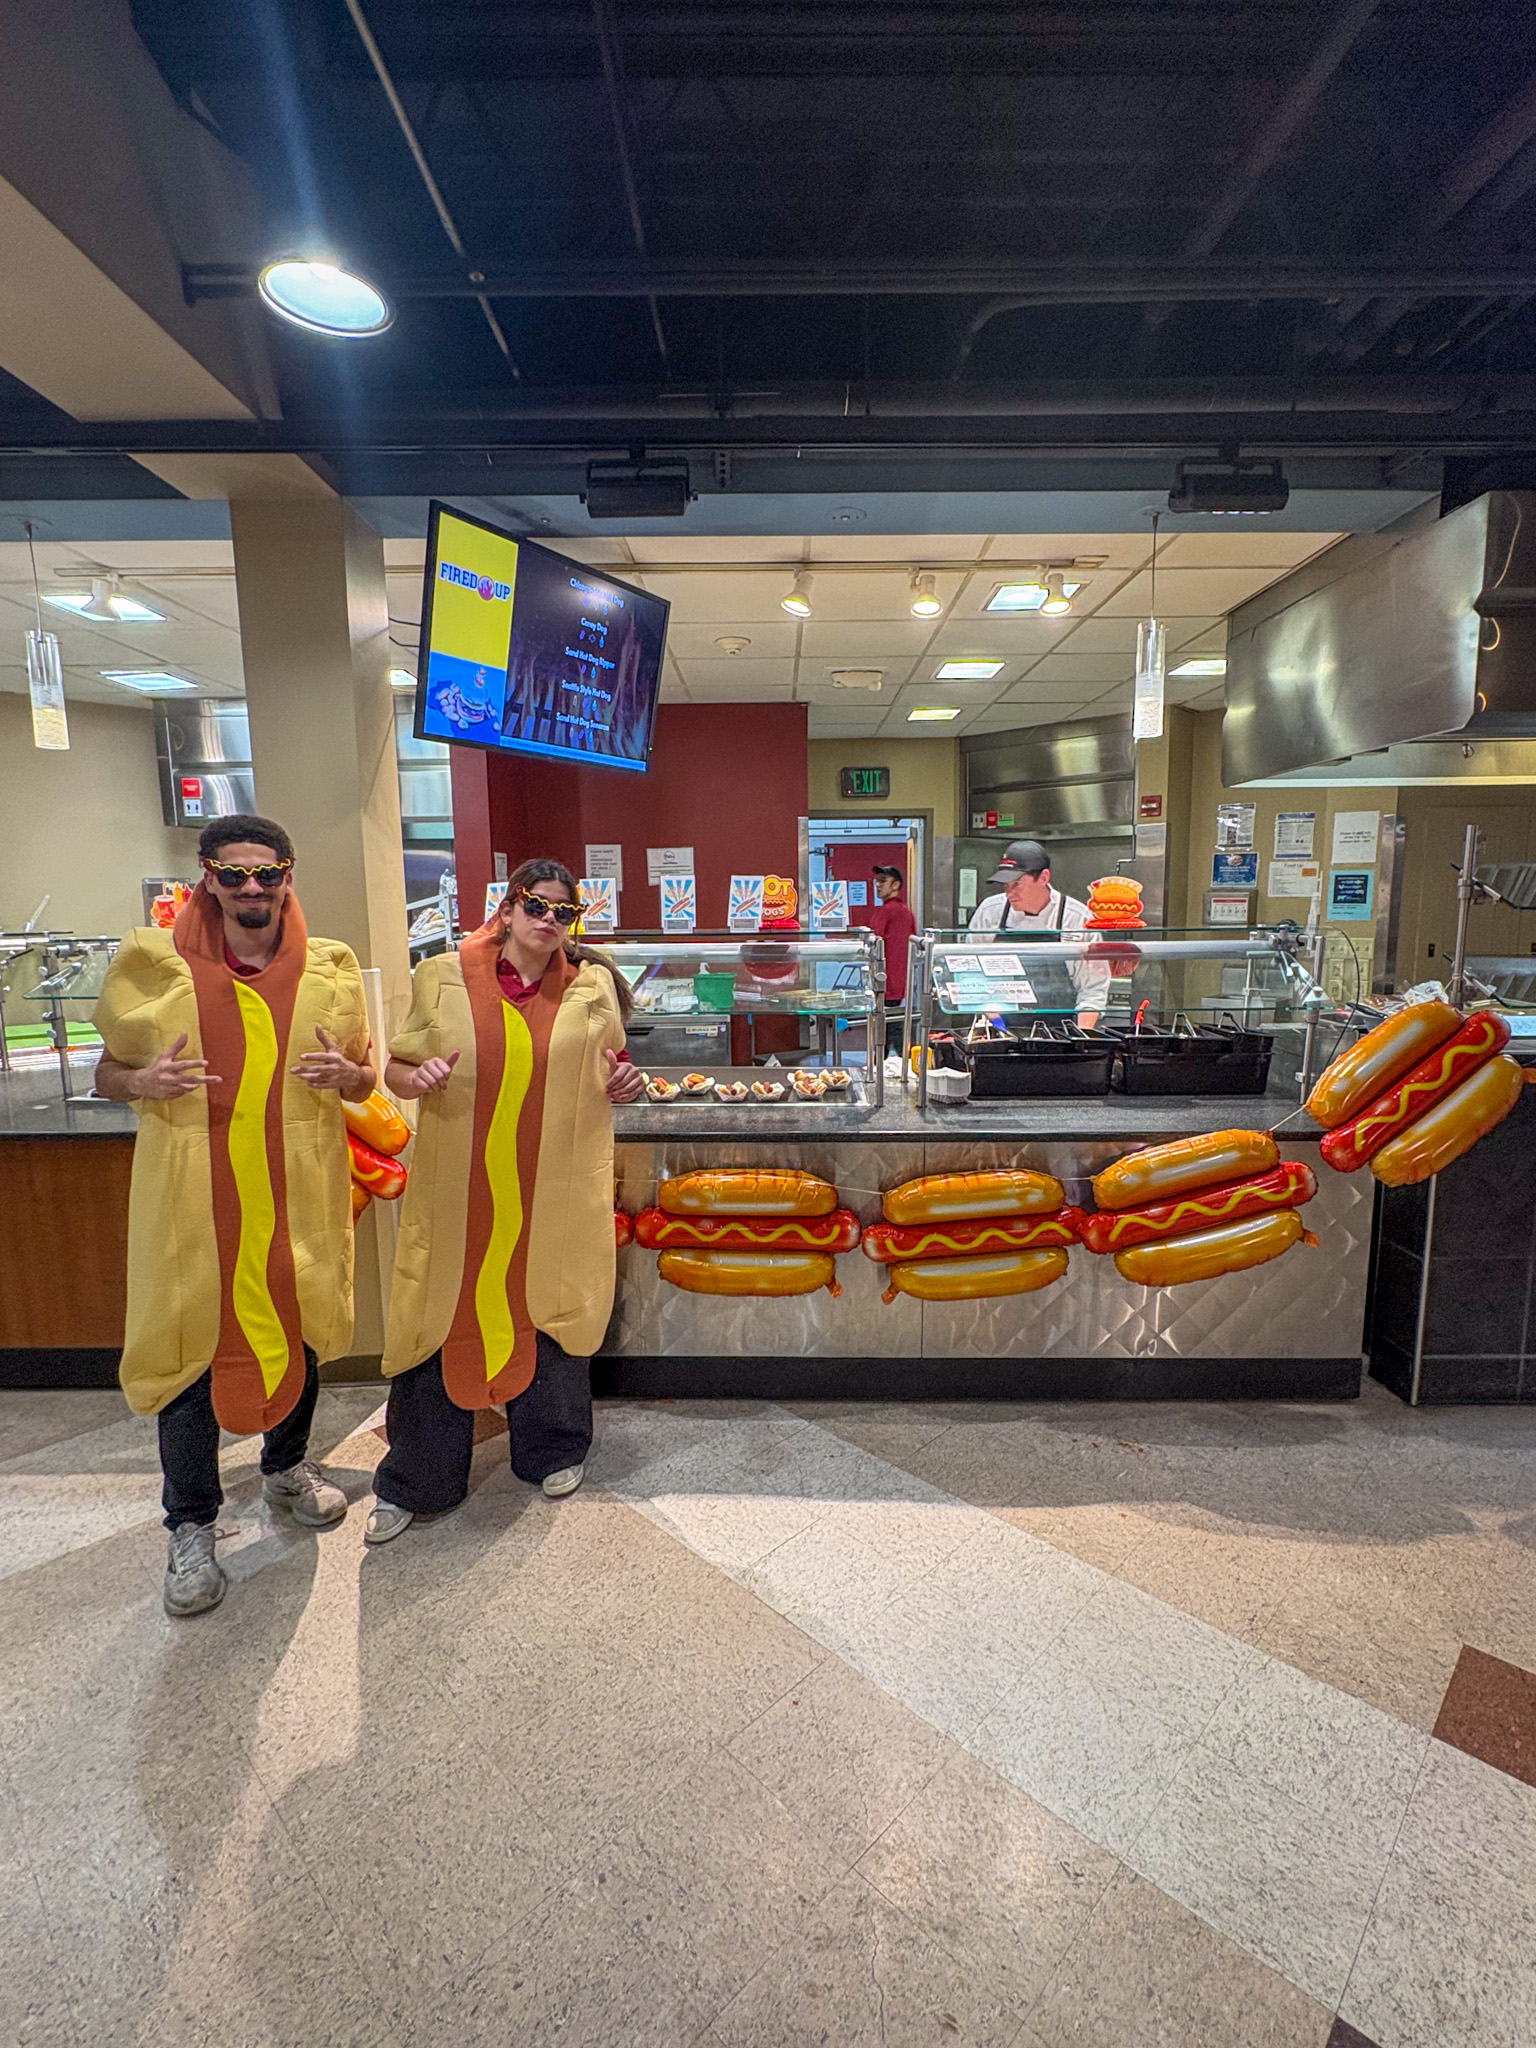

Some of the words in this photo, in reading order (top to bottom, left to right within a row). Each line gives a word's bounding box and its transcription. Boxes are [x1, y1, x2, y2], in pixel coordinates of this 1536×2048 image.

[440, 561, 479, 589] FIRED
[495, 581, 511, 600] UP
[596, 622, 608, 635] Dog
[579, 651, 588, 660] Hot
[588, 654, 599, 666] Dog
[591, 687, 601, 697] Hot
[601, 690, 612, 702] Dog
[569, 715, 579, 725] Hot
[579, 717, 590, 729] Dog
[853, 770, 882, 792] EXIT
[764, 878, 791, 896] OT
